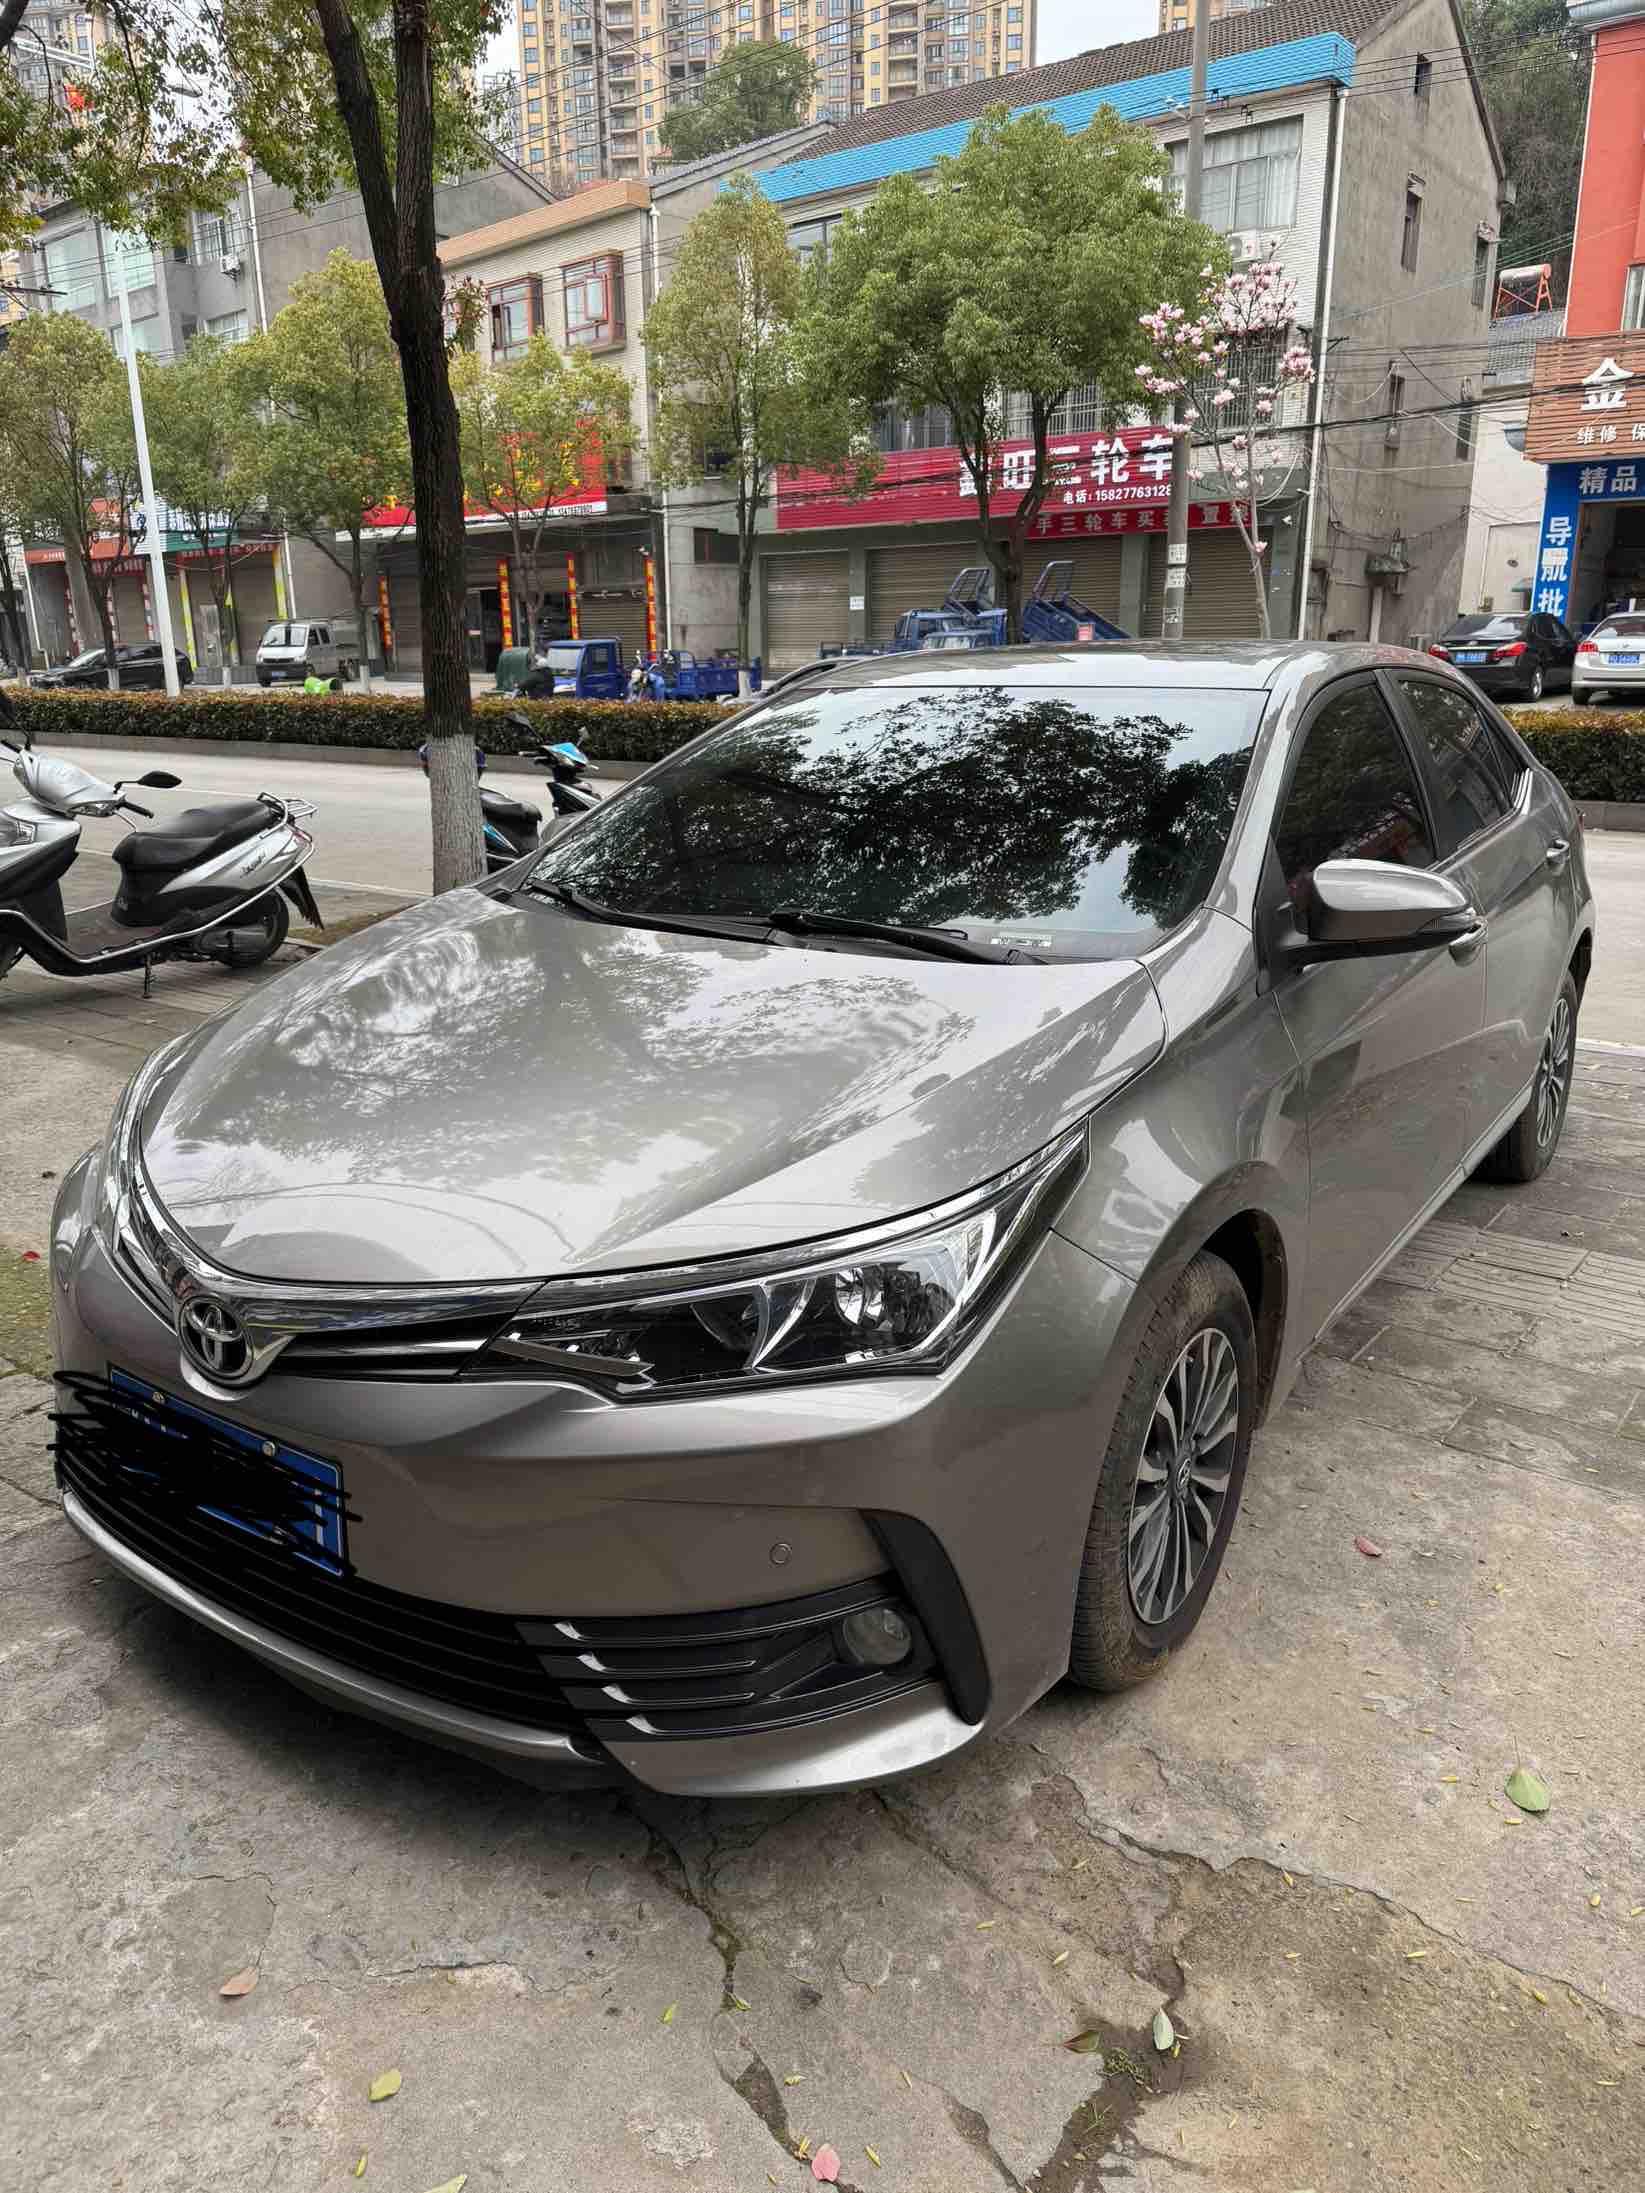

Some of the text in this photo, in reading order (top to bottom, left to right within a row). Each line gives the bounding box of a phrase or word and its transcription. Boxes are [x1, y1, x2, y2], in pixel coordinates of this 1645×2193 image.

[1580, 357, 1634, 411] 金
[1576, 424, 1617, 445] 维修
[1579, 465, 1637, 495] 精品
